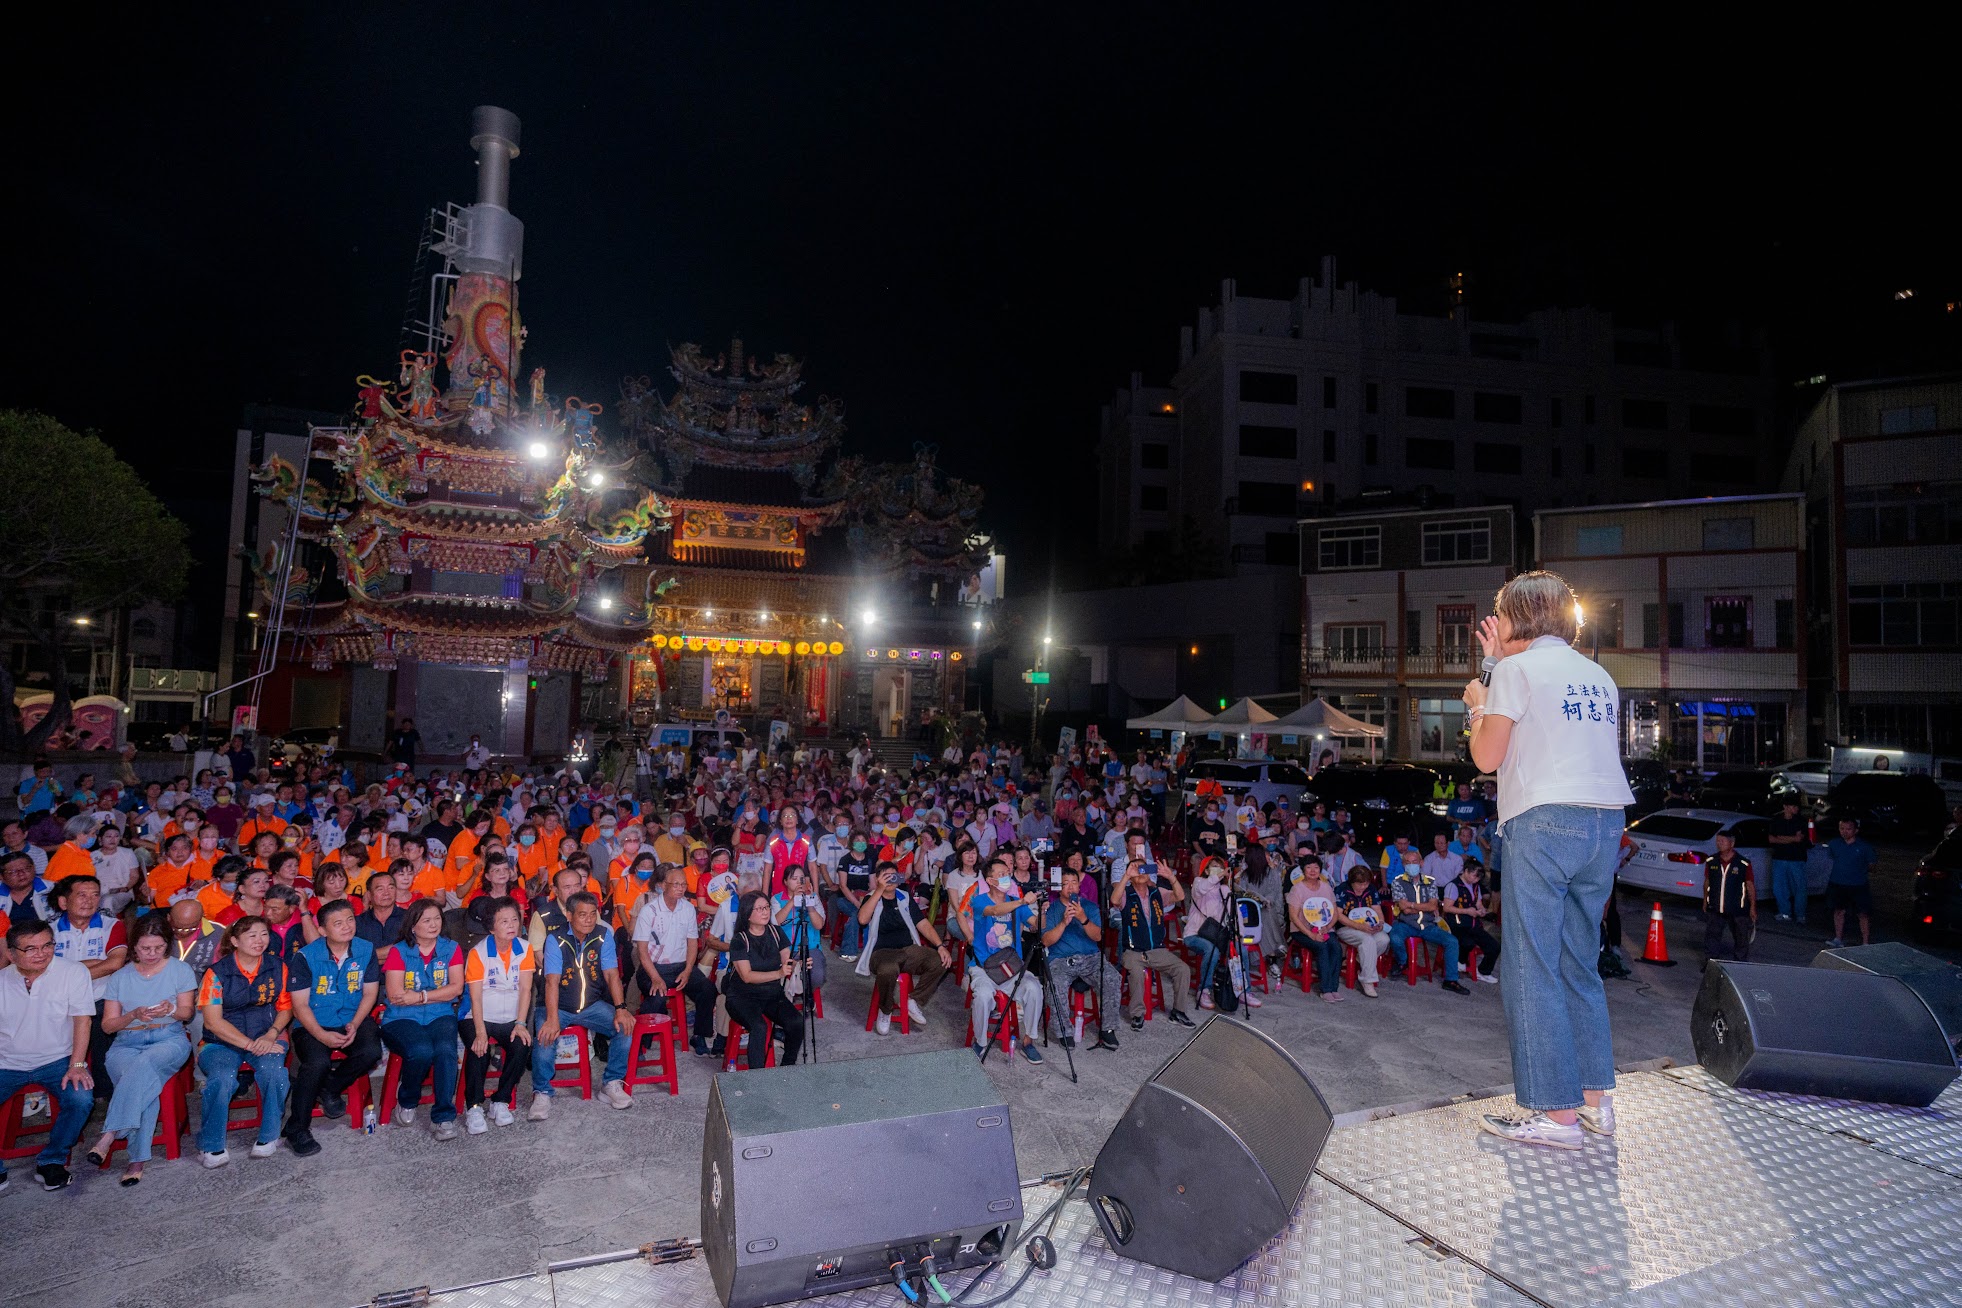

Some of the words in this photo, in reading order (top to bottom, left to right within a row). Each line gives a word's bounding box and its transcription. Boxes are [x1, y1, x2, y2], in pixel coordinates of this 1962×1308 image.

[1567, 684, 1610, 700] 立法委員
[1561, 700, 1615, 725] 柯志恩
[1457, 806, 1474, 814] LOTTO
